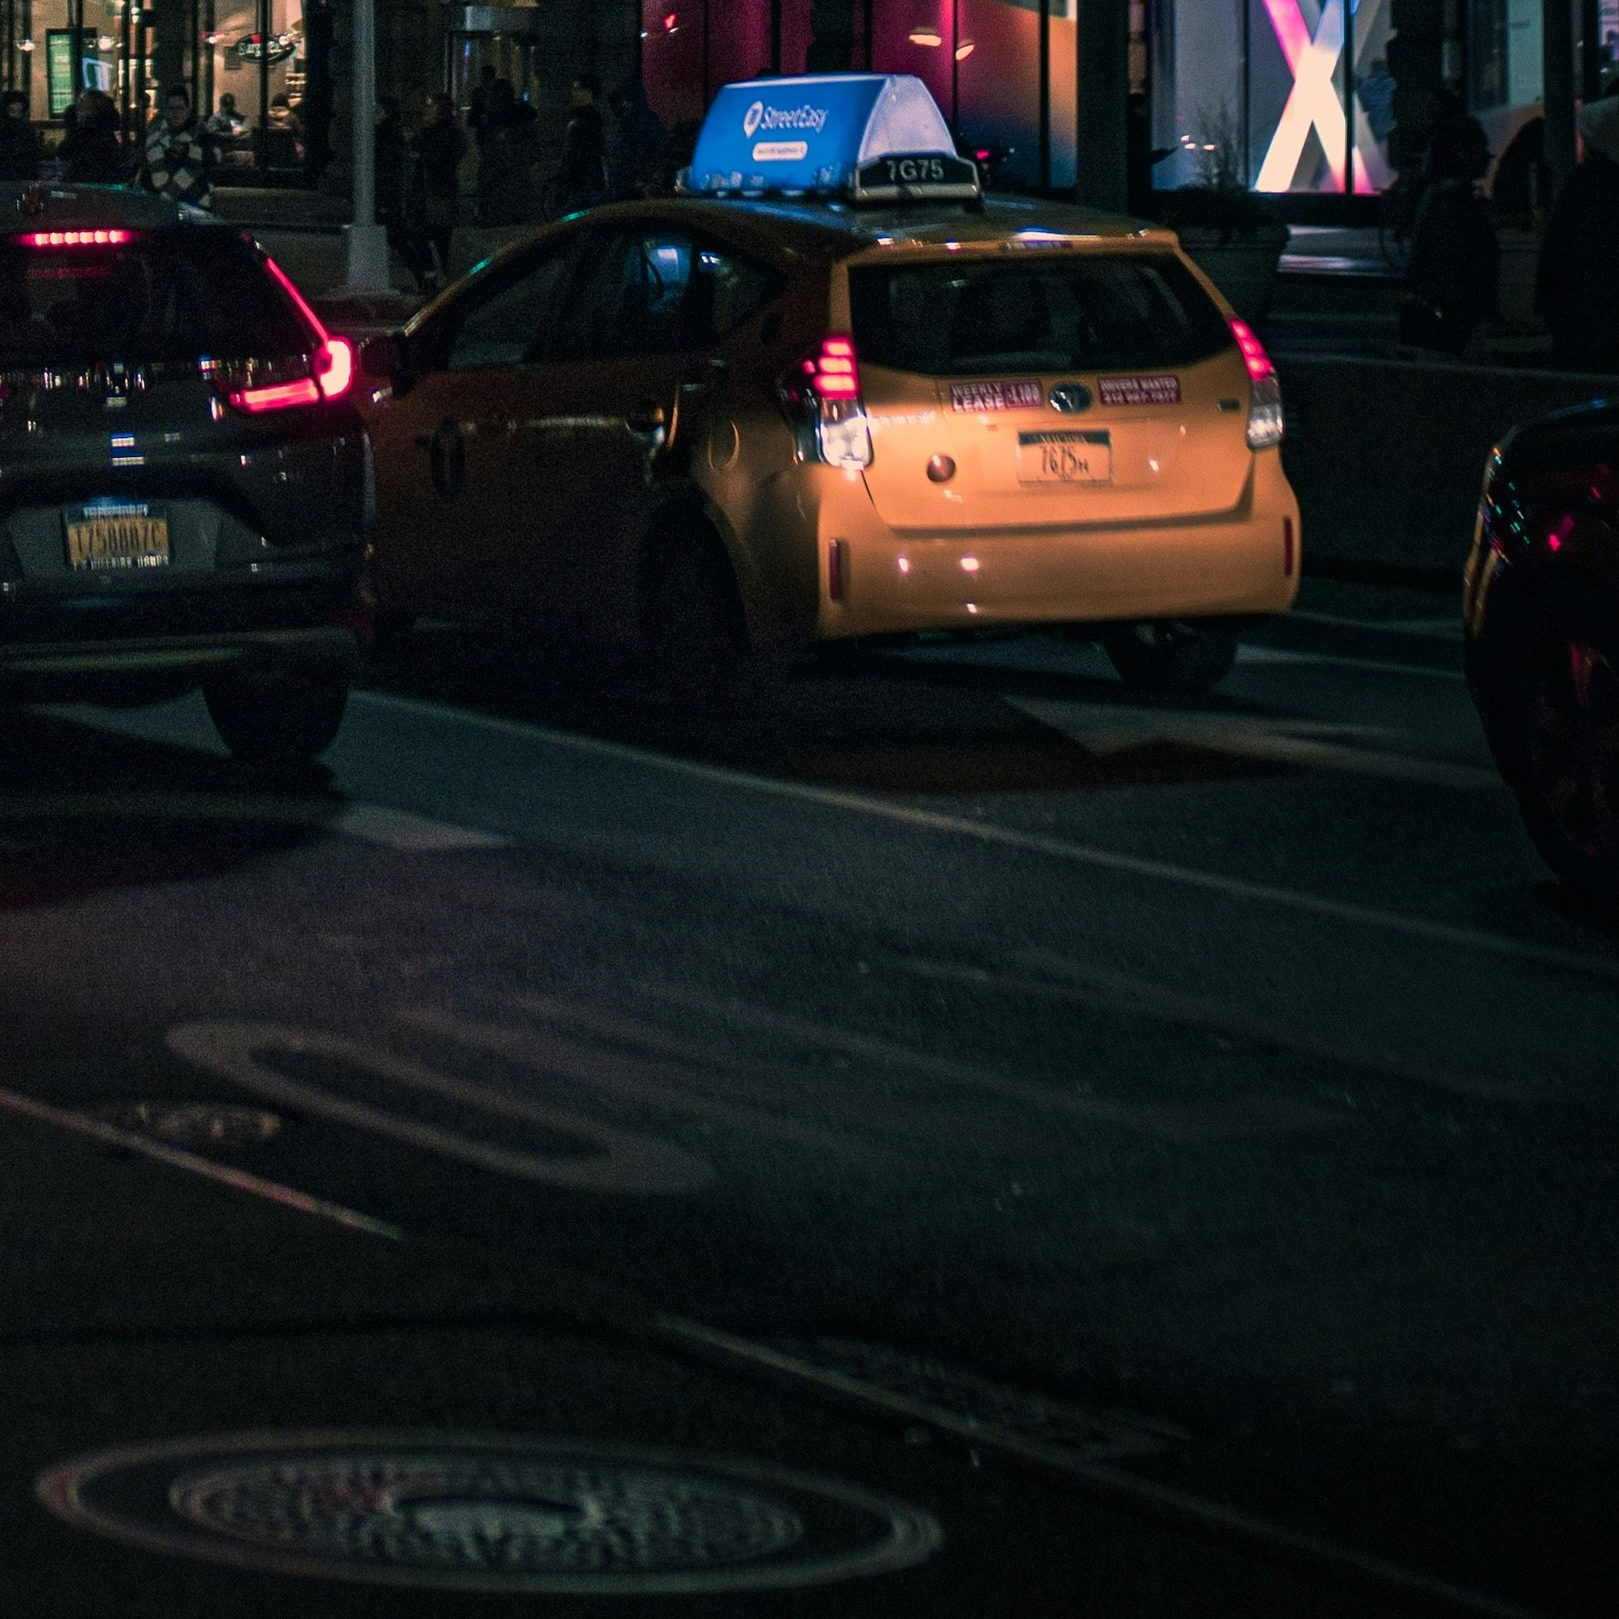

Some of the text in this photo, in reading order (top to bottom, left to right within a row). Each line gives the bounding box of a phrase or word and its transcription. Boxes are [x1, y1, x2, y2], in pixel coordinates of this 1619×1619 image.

[760, 104, 829, 134] StreetEasy
[887, 159, 943, 182] 7G75
[951, 395, 1007, 413] LEASE
